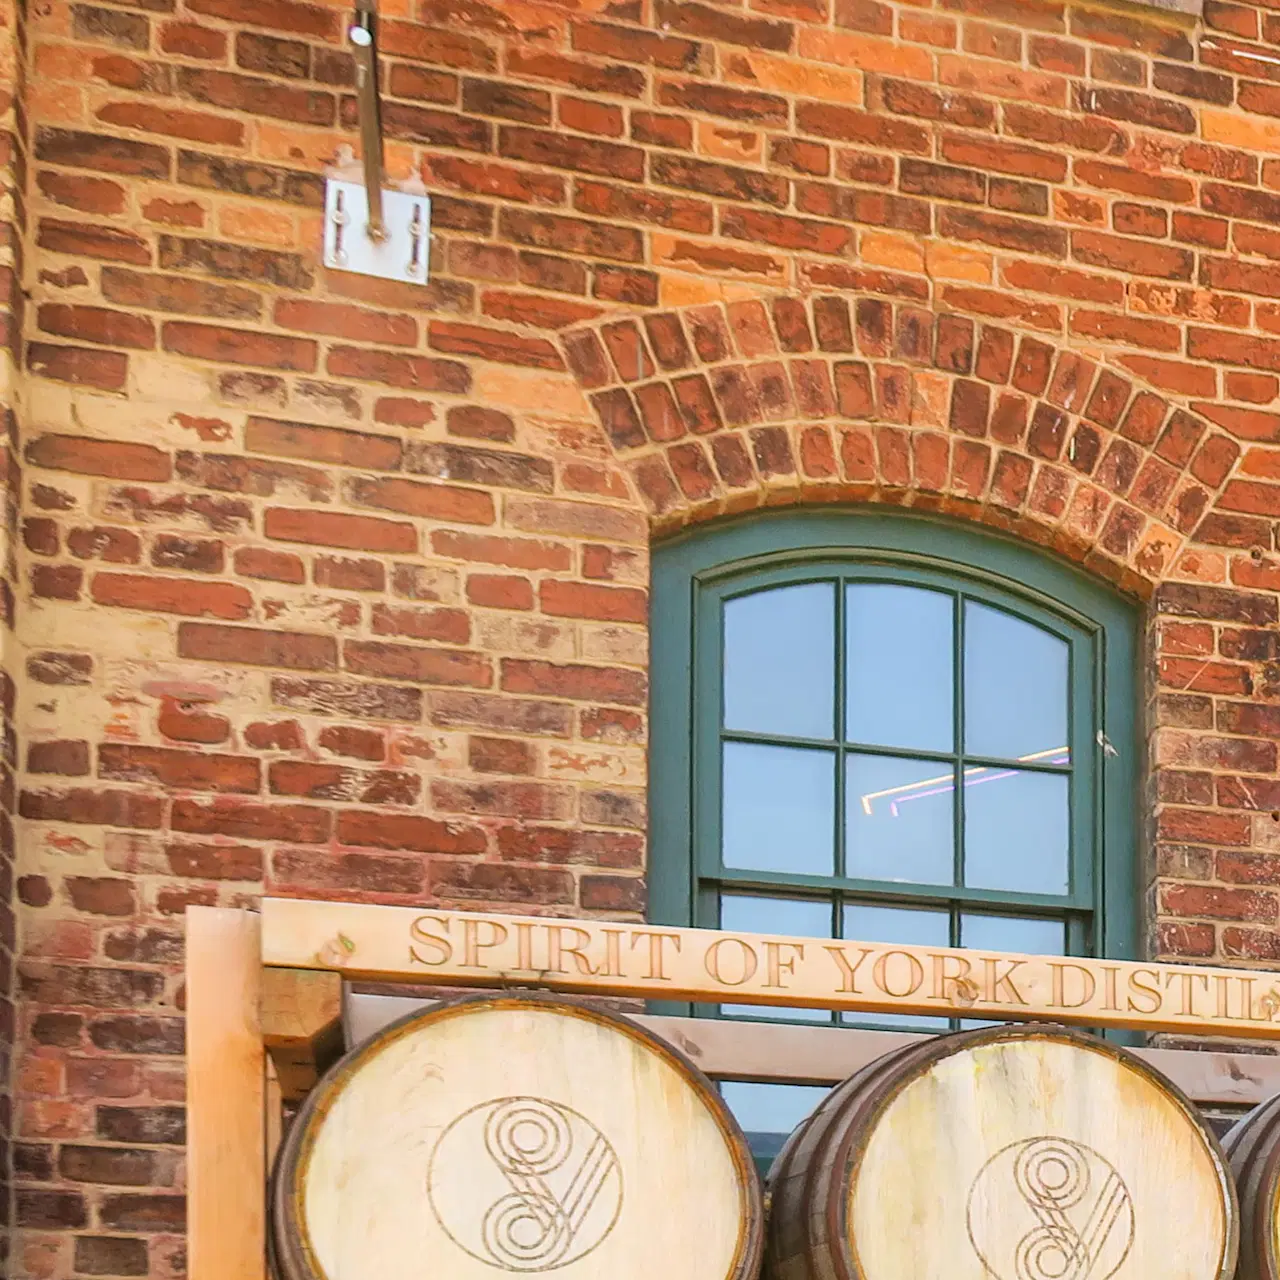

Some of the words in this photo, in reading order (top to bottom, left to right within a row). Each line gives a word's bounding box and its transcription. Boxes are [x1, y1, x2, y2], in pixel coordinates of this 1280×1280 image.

[408, 914, 681, 981] SPIRIT
[704, 938, 804, 988] OF
[824, 945, 1042, 1005] YORK
